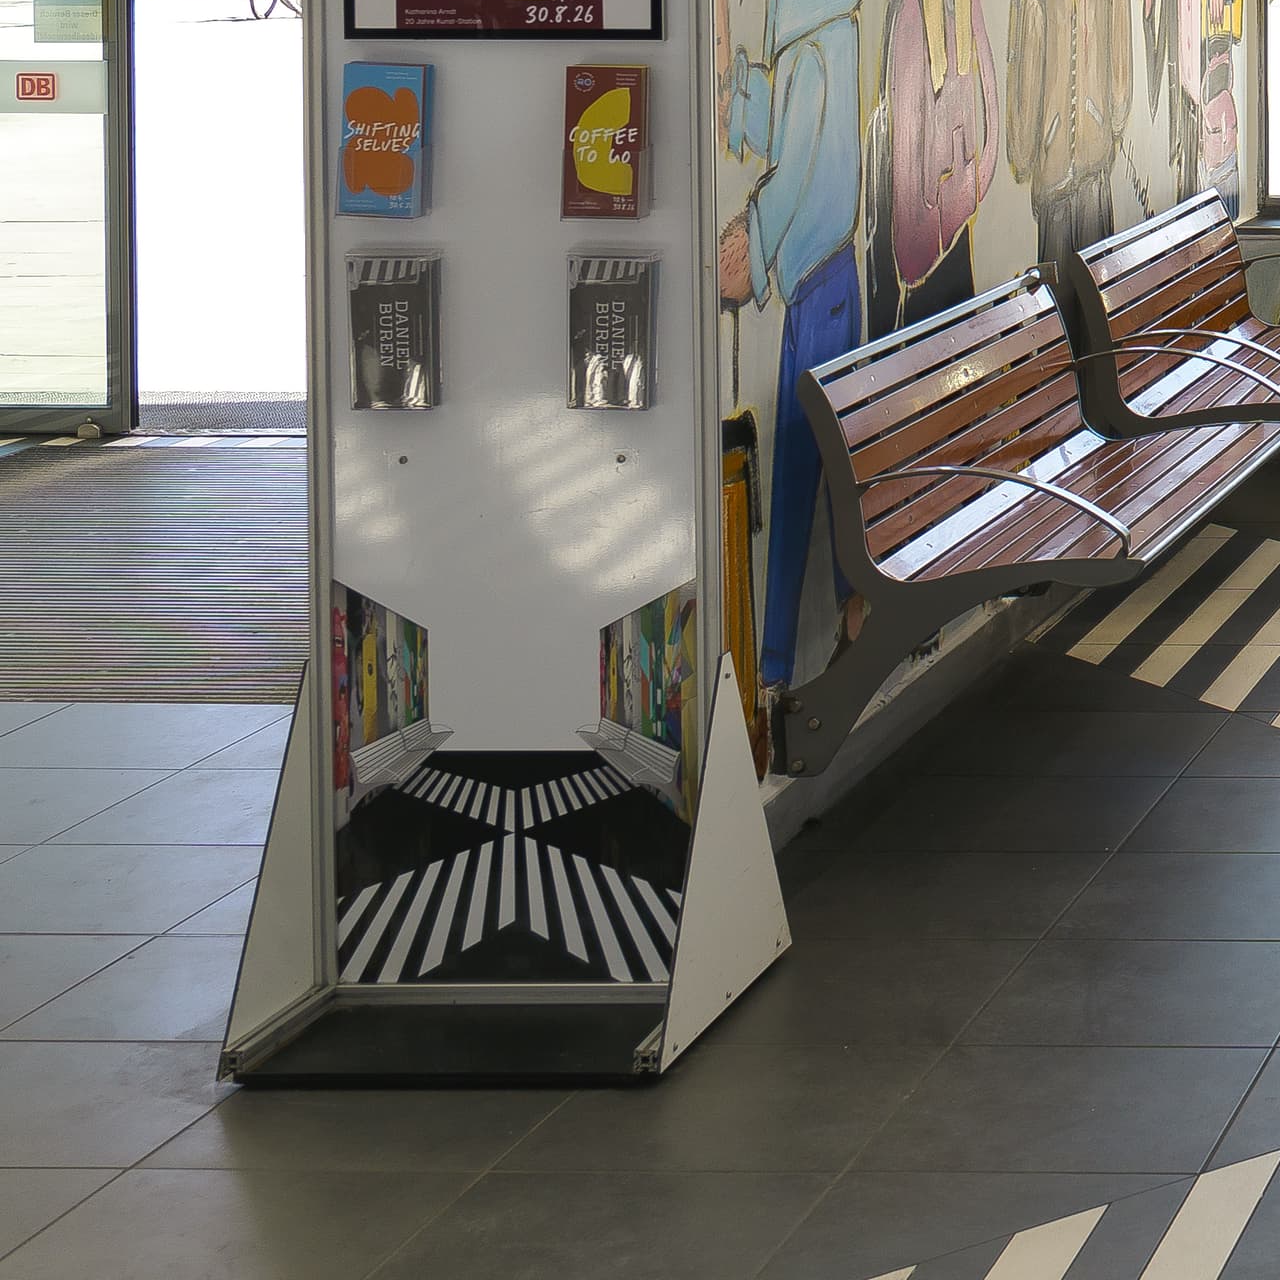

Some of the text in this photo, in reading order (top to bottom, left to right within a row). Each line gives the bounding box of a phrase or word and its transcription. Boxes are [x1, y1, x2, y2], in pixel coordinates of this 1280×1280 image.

[525, 4, 594, 24] 30.8.26
[20, 76, 52, 98] DB
[343, 119, 422, 140] SHIFTING
[568, 125, 639, 145] COFFEE
[354, 136, 412, 154] SELVES
[576, 145, 598, 163] TO
[378, 302, 395, 368] BUREN
[394, 300, 411, 371] DANIEL
[595, 302, 610, 367] BUREN
[610, 300, 626, 371] DANIEL
